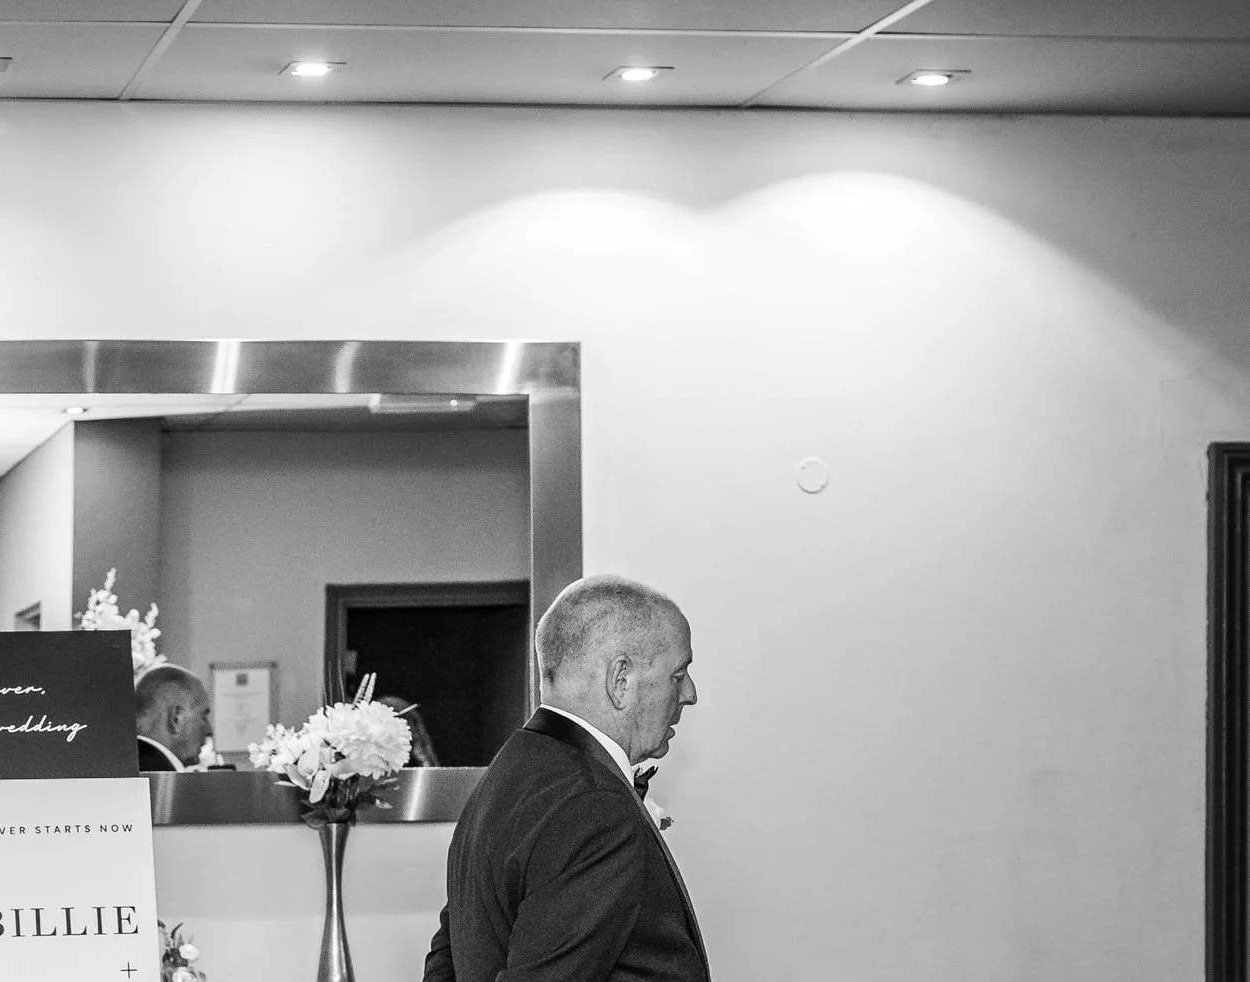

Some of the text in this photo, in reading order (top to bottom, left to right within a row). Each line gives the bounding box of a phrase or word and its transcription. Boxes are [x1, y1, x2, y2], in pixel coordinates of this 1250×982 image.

[35, 824, 92, 835] STARTS
[99, 823, 134, 833] NOW
[120, 961, 138, 979] +
